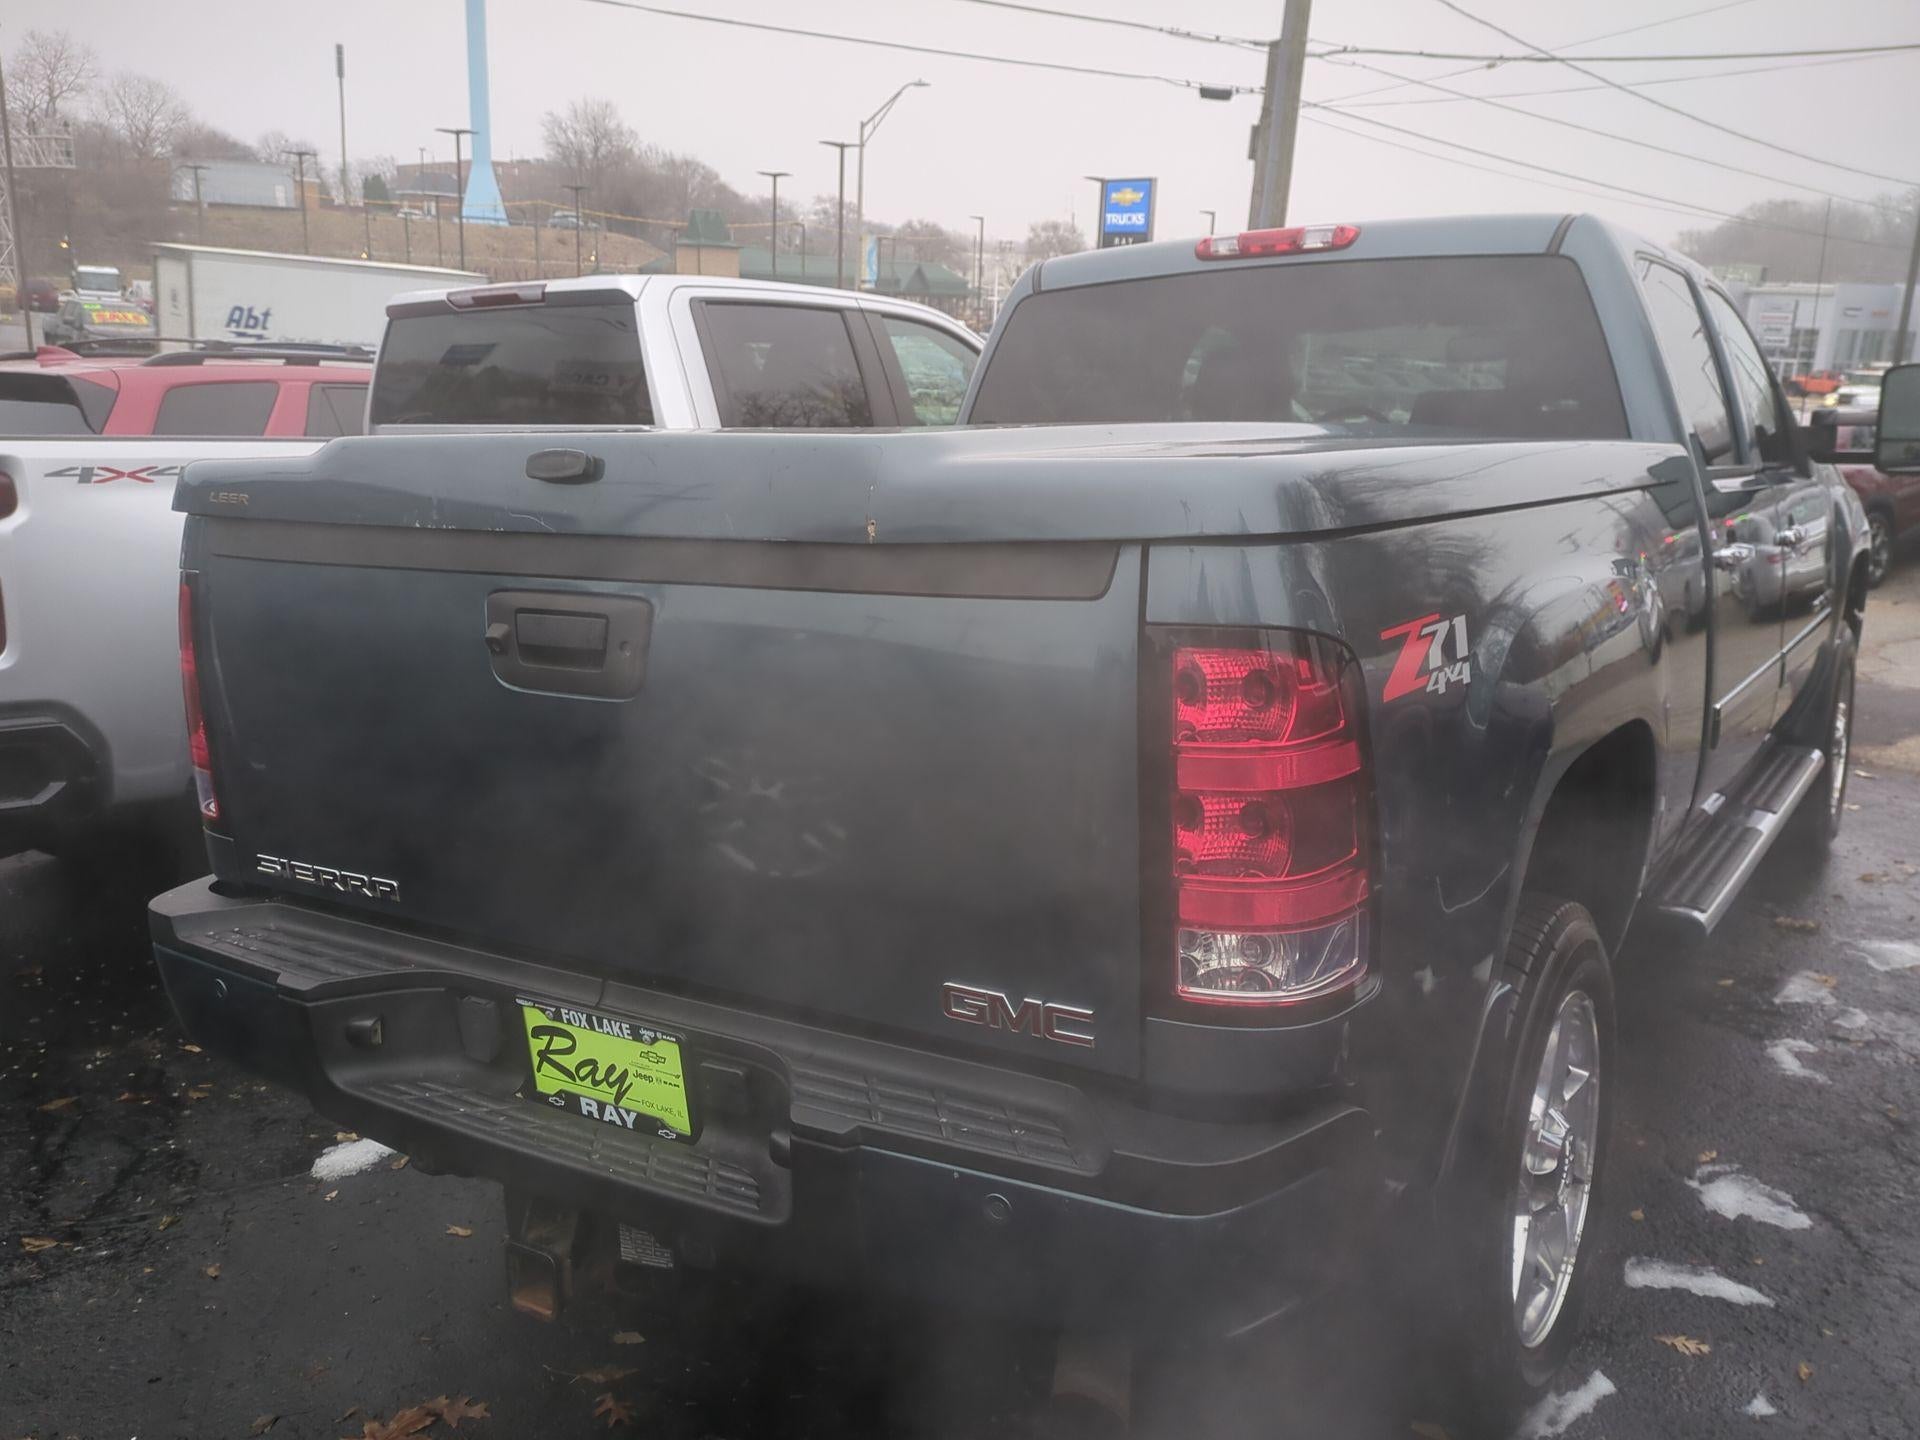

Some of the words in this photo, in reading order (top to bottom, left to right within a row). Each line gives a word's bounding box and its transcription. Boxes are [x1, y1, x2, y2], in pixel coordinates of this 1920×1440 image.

[1106, 213, 1145, 225] TRUCKS
[224, 304, 272, 330] Abt
[209, 491, 249, 505] LEER
[1381, 612, 1469, 704] Z71
[256, 853, 401, 903] SIERRA
[560, 1007, 590, 1030] FOX
[592, 1016, 633, 1040] LAKE
[943, 981, 1095, 1049] GMC
[530, 1024, 633, 1106] Ray
[632, 1069, 654, 1084] Jeep
[580, 1096, 638, 1130] RAY
[641, 1099, 655, 1110] FOX
